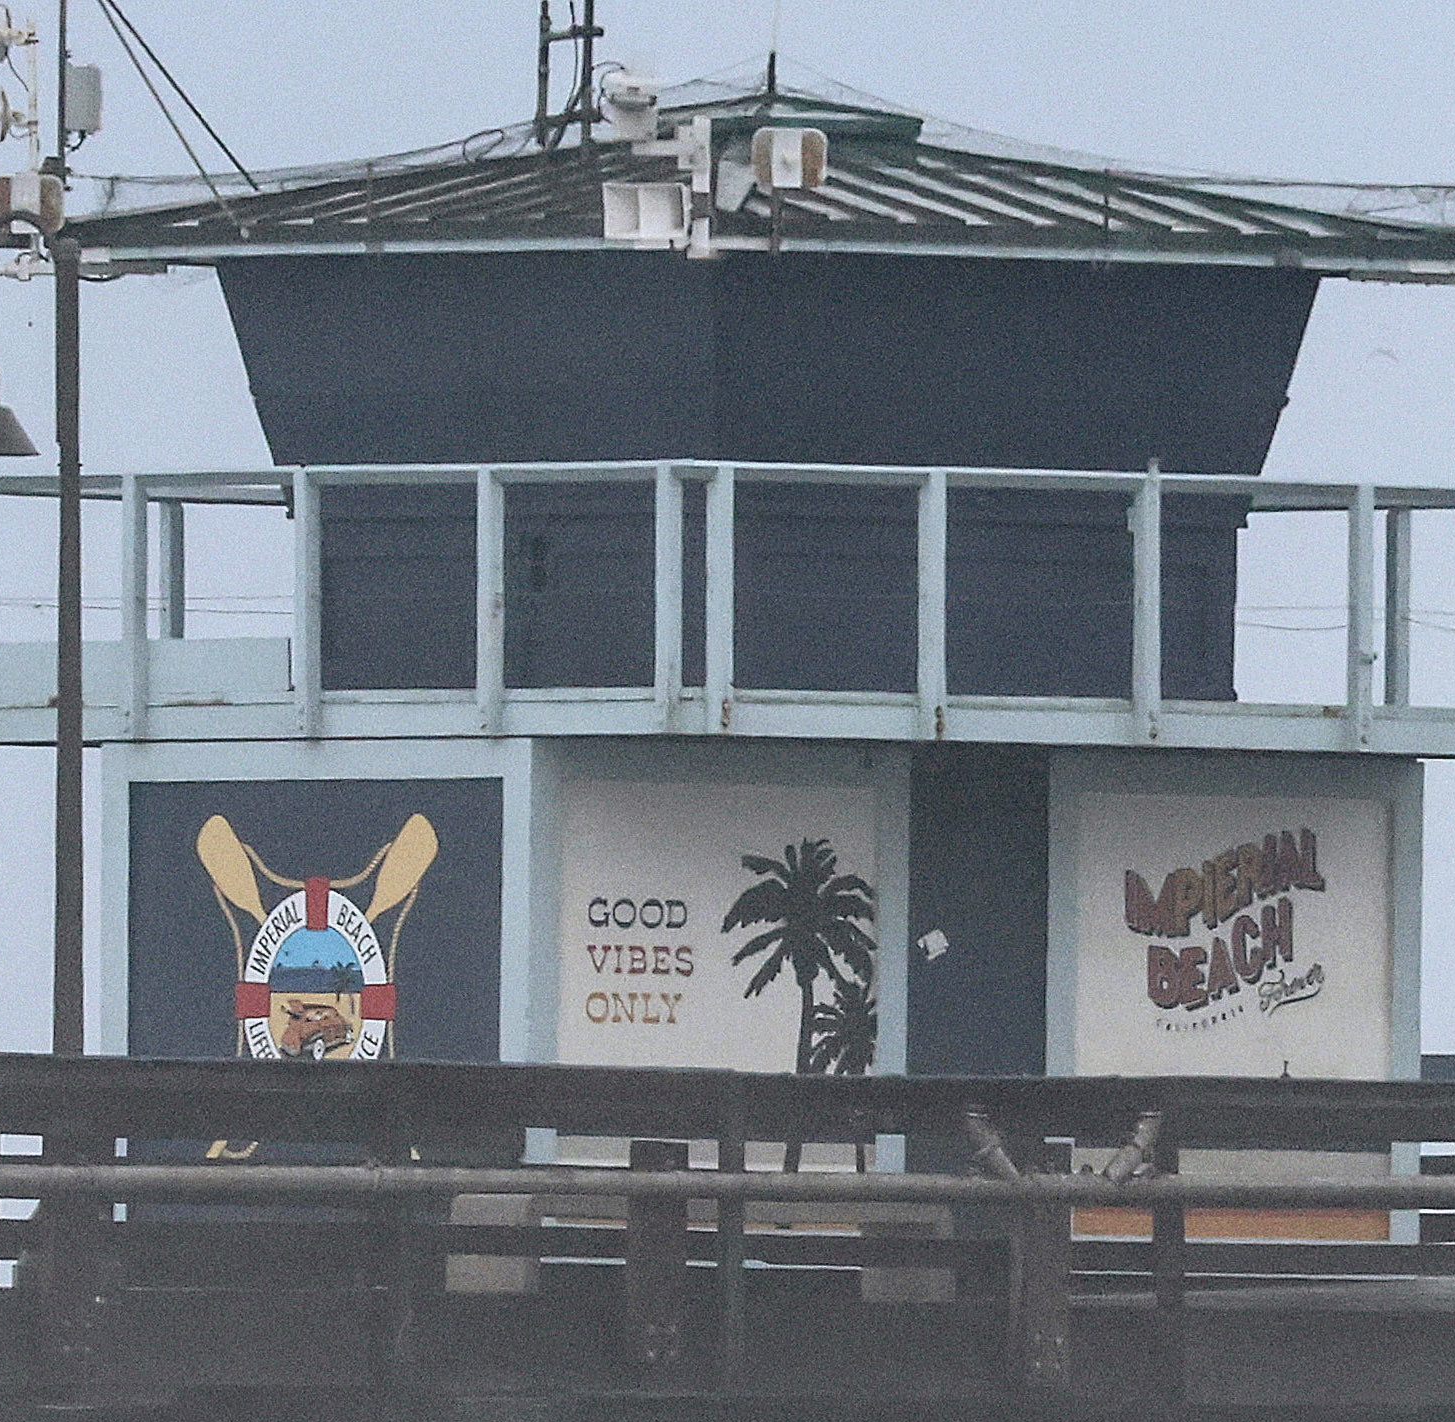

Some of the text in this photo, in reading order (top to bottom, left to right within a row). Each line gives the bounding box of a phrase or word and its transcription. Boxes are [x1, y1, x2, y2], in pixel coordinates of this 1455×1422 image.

[587, 897, 688, 928] GOOD
[250, 901, 377, 976] IMPERIAL BEACH
[1147, 897, 1294, 1010] BEACH
[586, 944, 694, 977] VIBES
[585, 992, 683, 1024] ONLY
